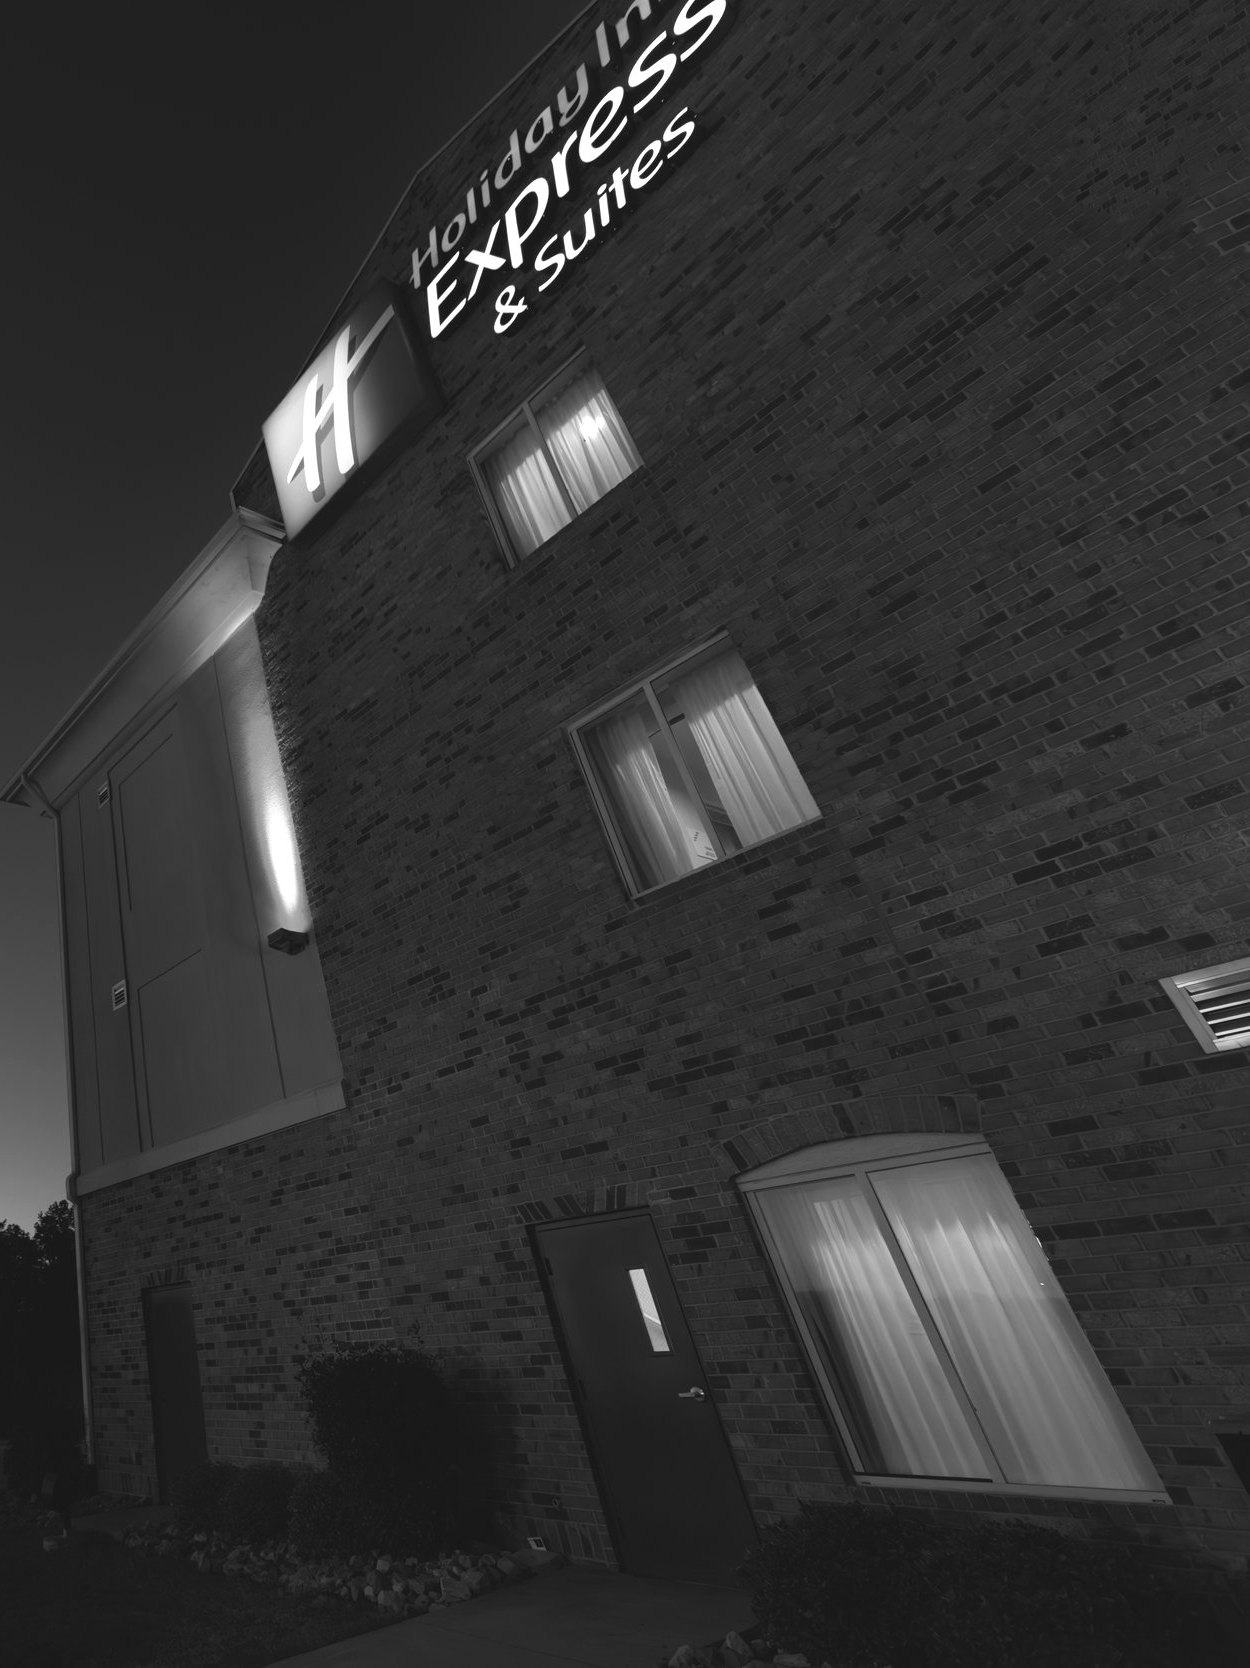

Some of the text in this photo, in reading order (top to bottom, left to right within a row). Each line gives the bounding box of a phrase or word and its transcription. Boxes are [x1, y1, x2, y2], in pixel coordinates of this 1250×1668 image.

[409, 0, 662, 290] Holiday In
[426, 0, 727, 339] Express
[493, 106, 696, 334] & Suites
[287, 304, 395, 493] H
